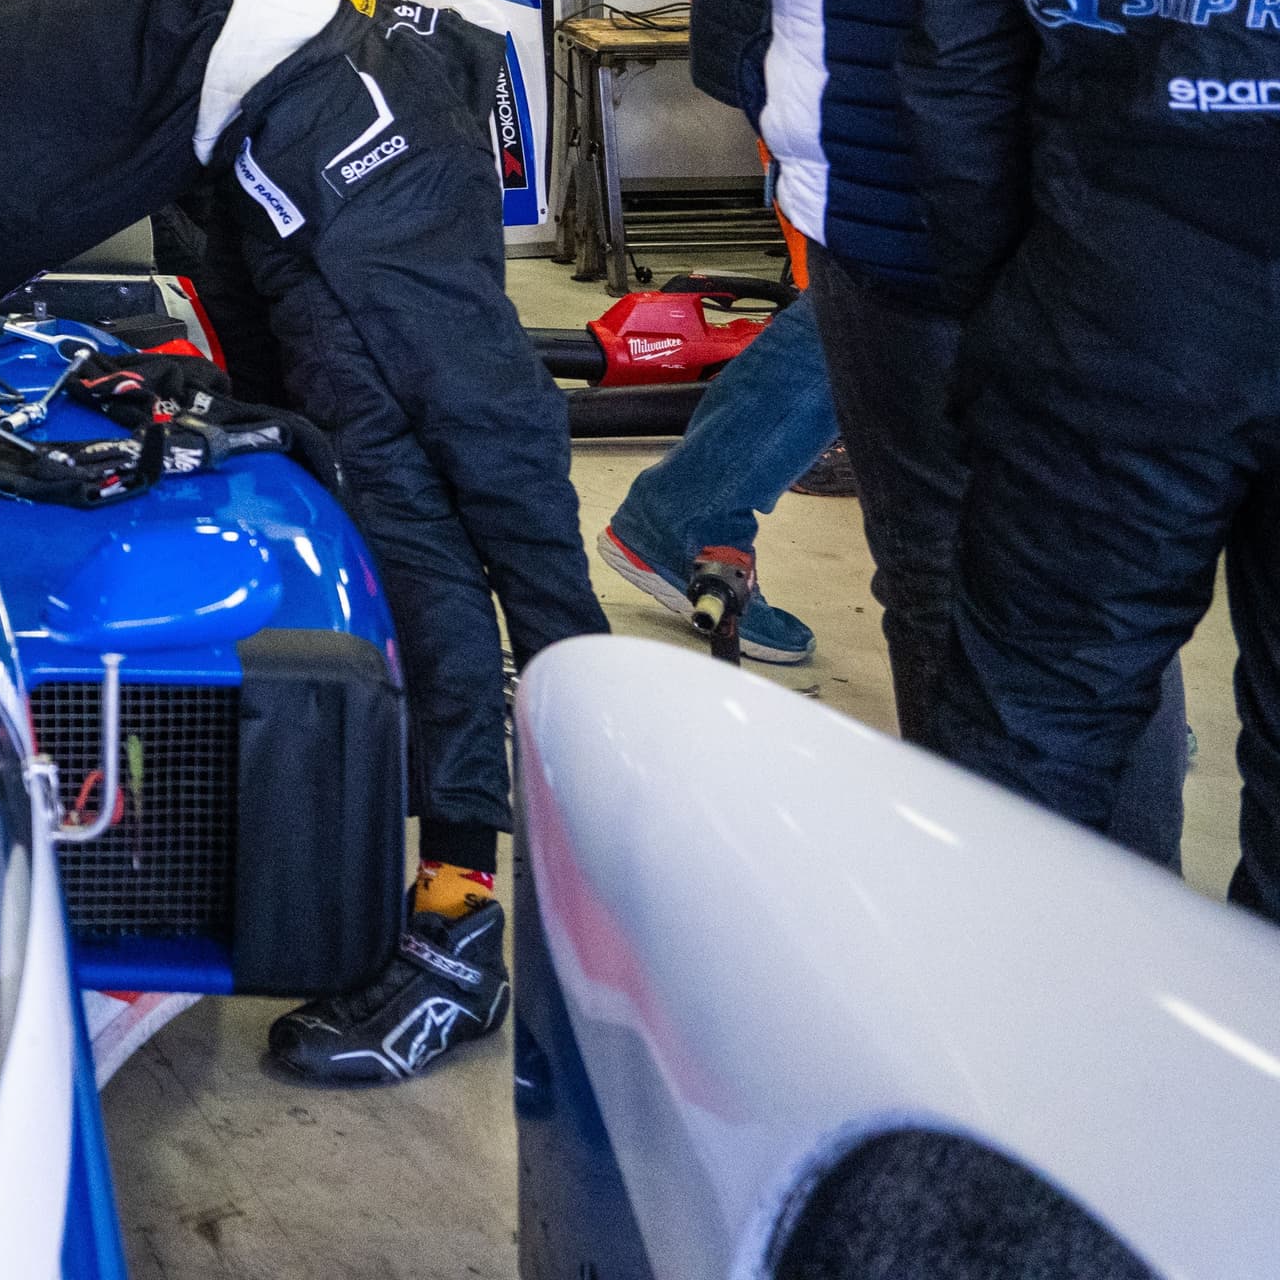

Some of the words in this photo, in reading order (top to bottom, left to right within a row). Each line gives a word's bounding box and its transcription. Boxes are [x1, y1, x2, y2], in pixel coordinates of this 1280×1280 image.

[1168, 78, 1280, 112] spar
[341, 136, 406, 180] sparco
[254, 183, 293, 226] RACING
[627, 337, 684, 355] Milwaukee
